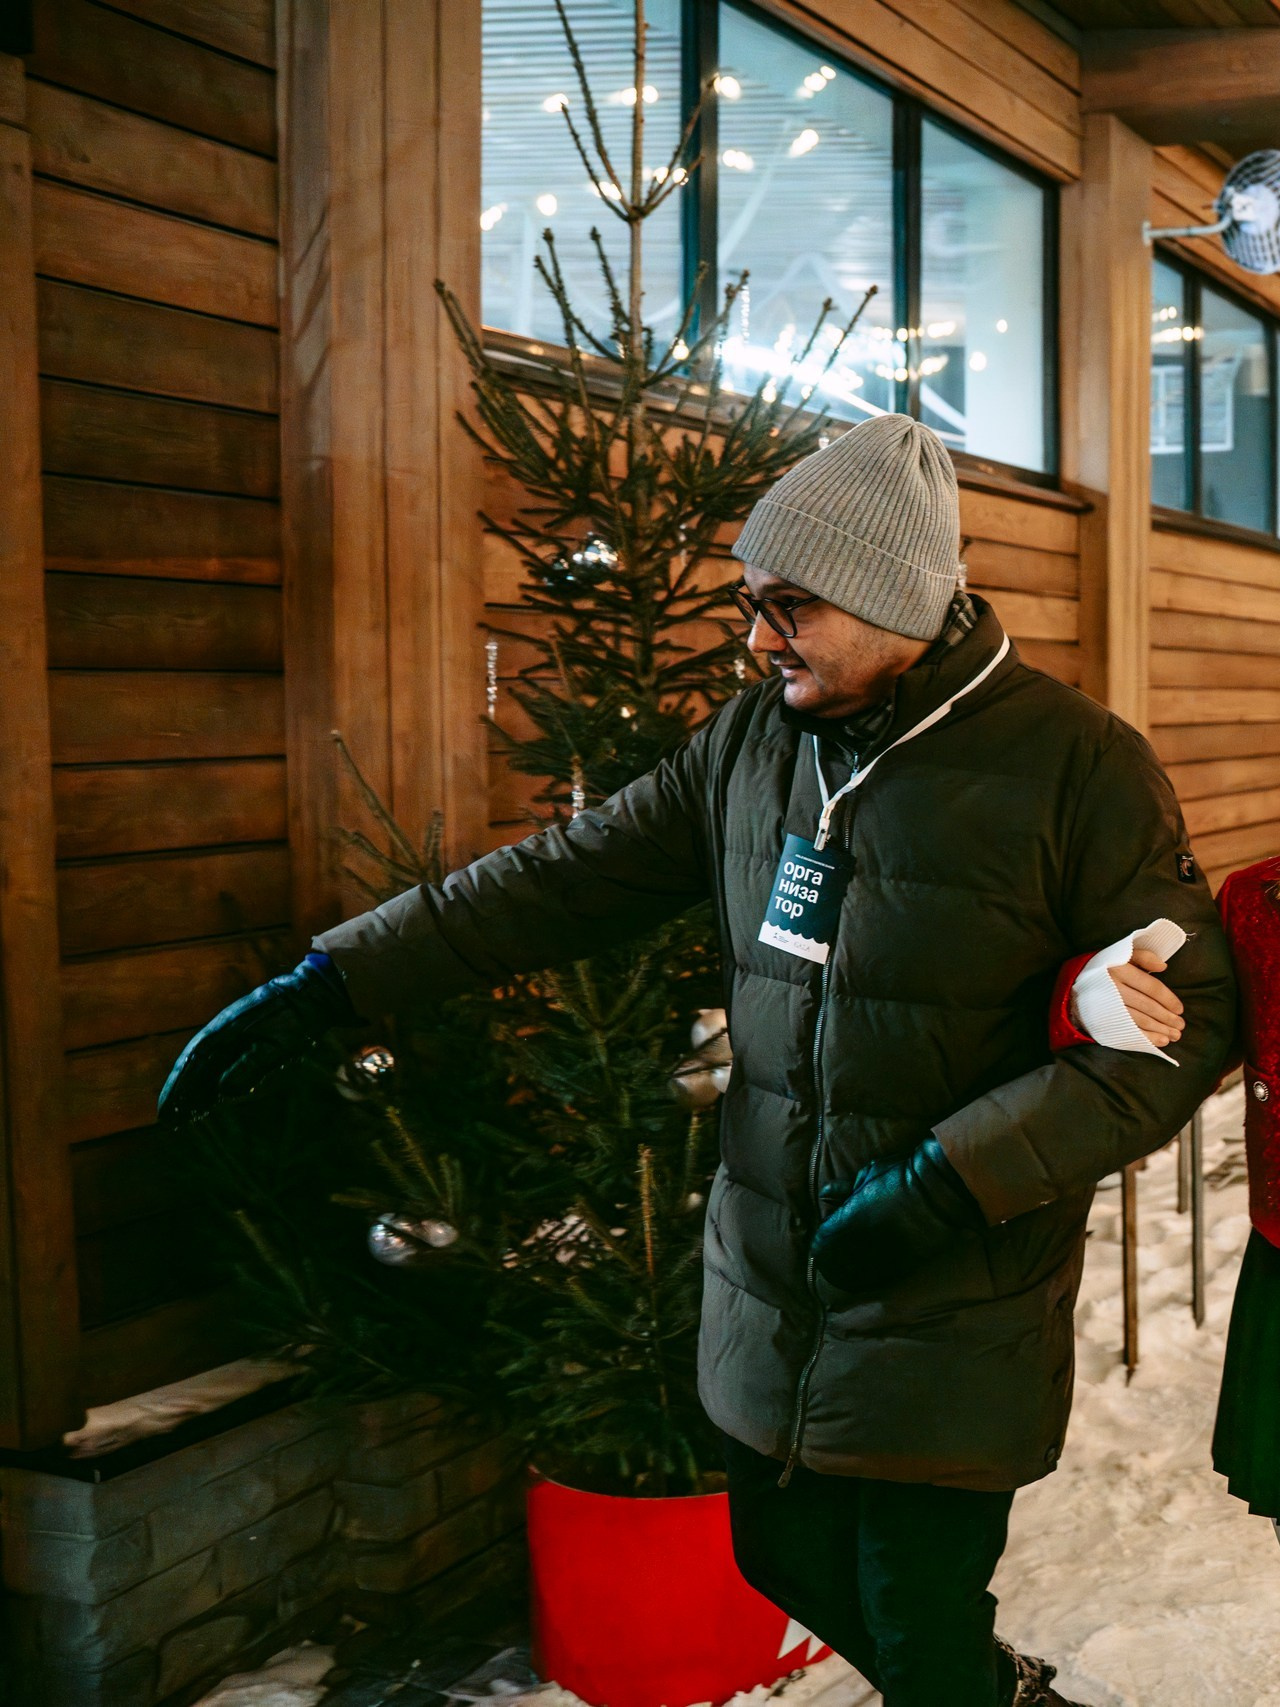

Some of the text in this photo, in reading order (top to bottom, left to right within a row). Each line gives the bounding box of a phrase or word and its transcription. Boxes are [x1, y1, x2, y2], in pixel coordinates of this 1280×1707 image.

[783, 861, 824, 886] орга
[778, 878, 819, 904] низа
[774, 895, 804, 919] тор
